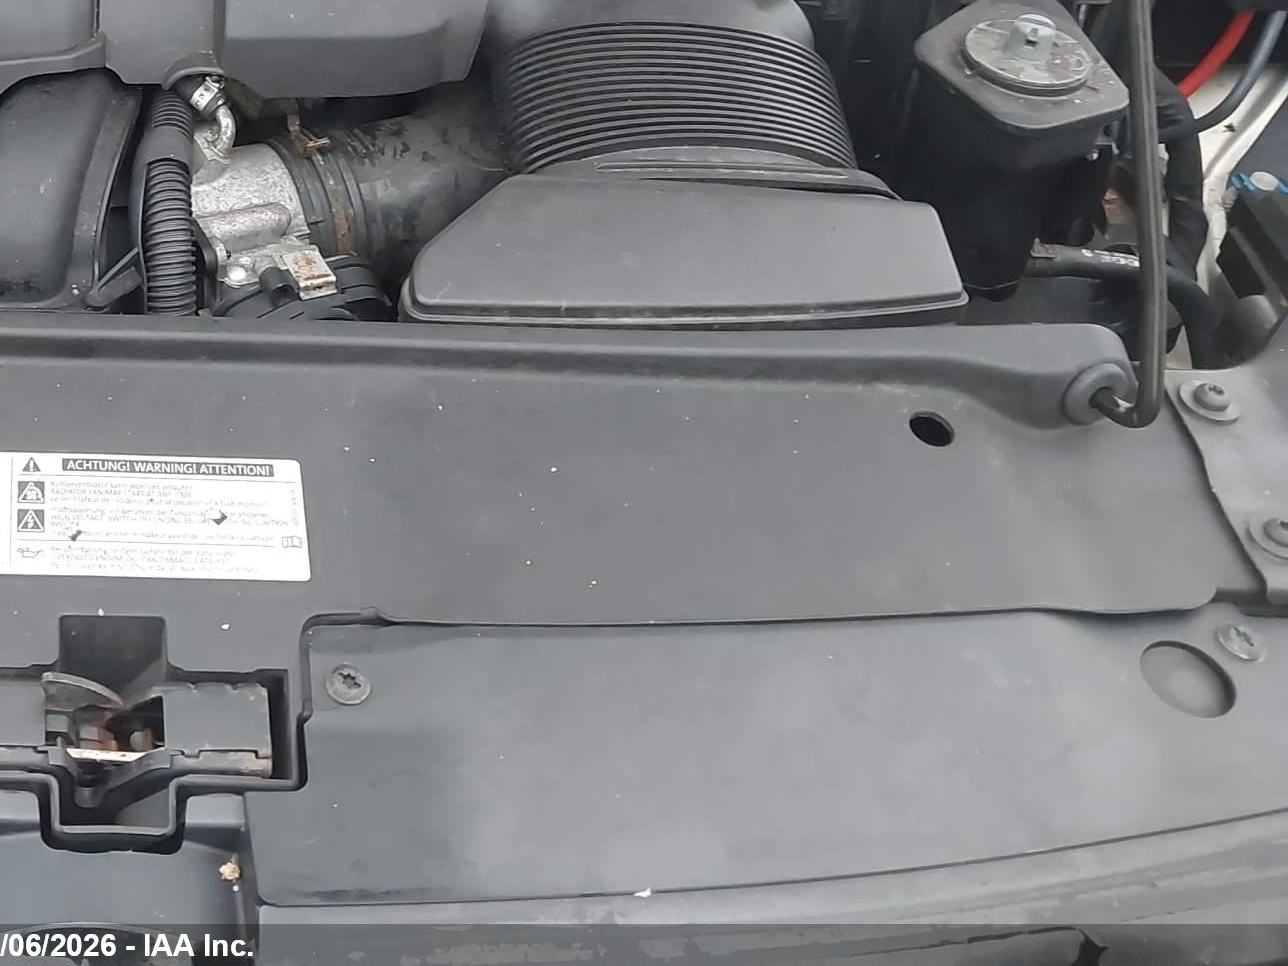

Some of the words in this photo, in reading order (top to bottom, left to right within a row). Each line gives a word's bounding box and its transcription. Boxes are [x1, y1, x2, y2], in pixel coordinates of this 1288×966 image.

[66, 460, 131, 472] ACHTUNG!
[133, 462, 197, 475] WARNING!
[199, 464, 270, 476] ATTENTION!
